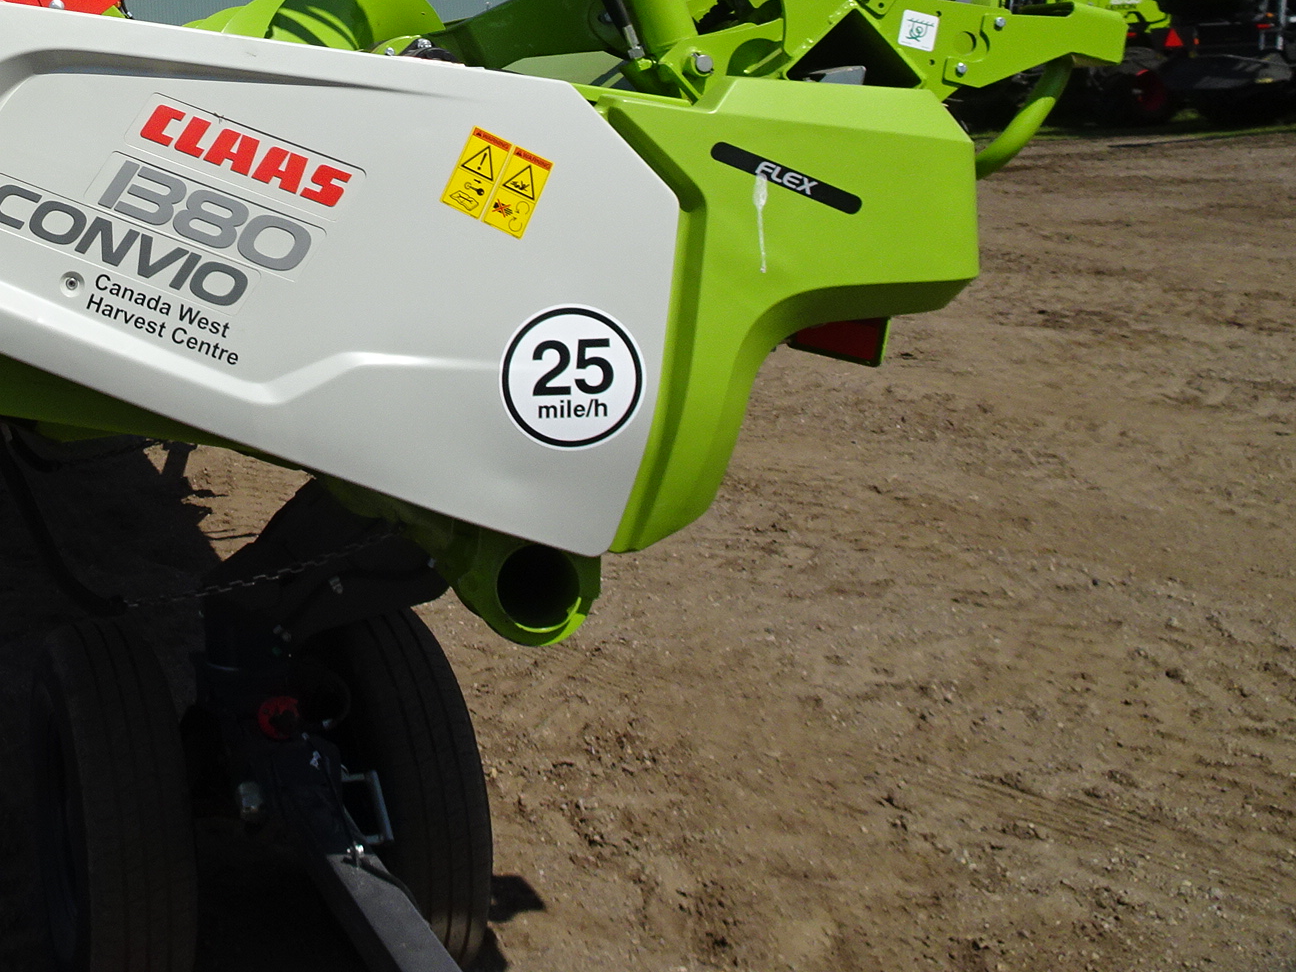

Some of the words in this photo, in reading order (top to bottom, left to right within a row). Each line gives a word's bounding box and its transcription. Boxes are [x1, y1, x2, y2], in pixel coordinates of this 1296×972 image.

[140, 104, 352, 207] CLAAS
[755, 161, 819, 195] FLEX
[86, 293, 167, 338] Harvest
[171, 327, 239, 365] Centre
[95, 274, 172, 316] Canada
[178, 303, 230, 338] West
[532, 338, 614, 396] 25
[538, 398, 608, 419] mile/h
